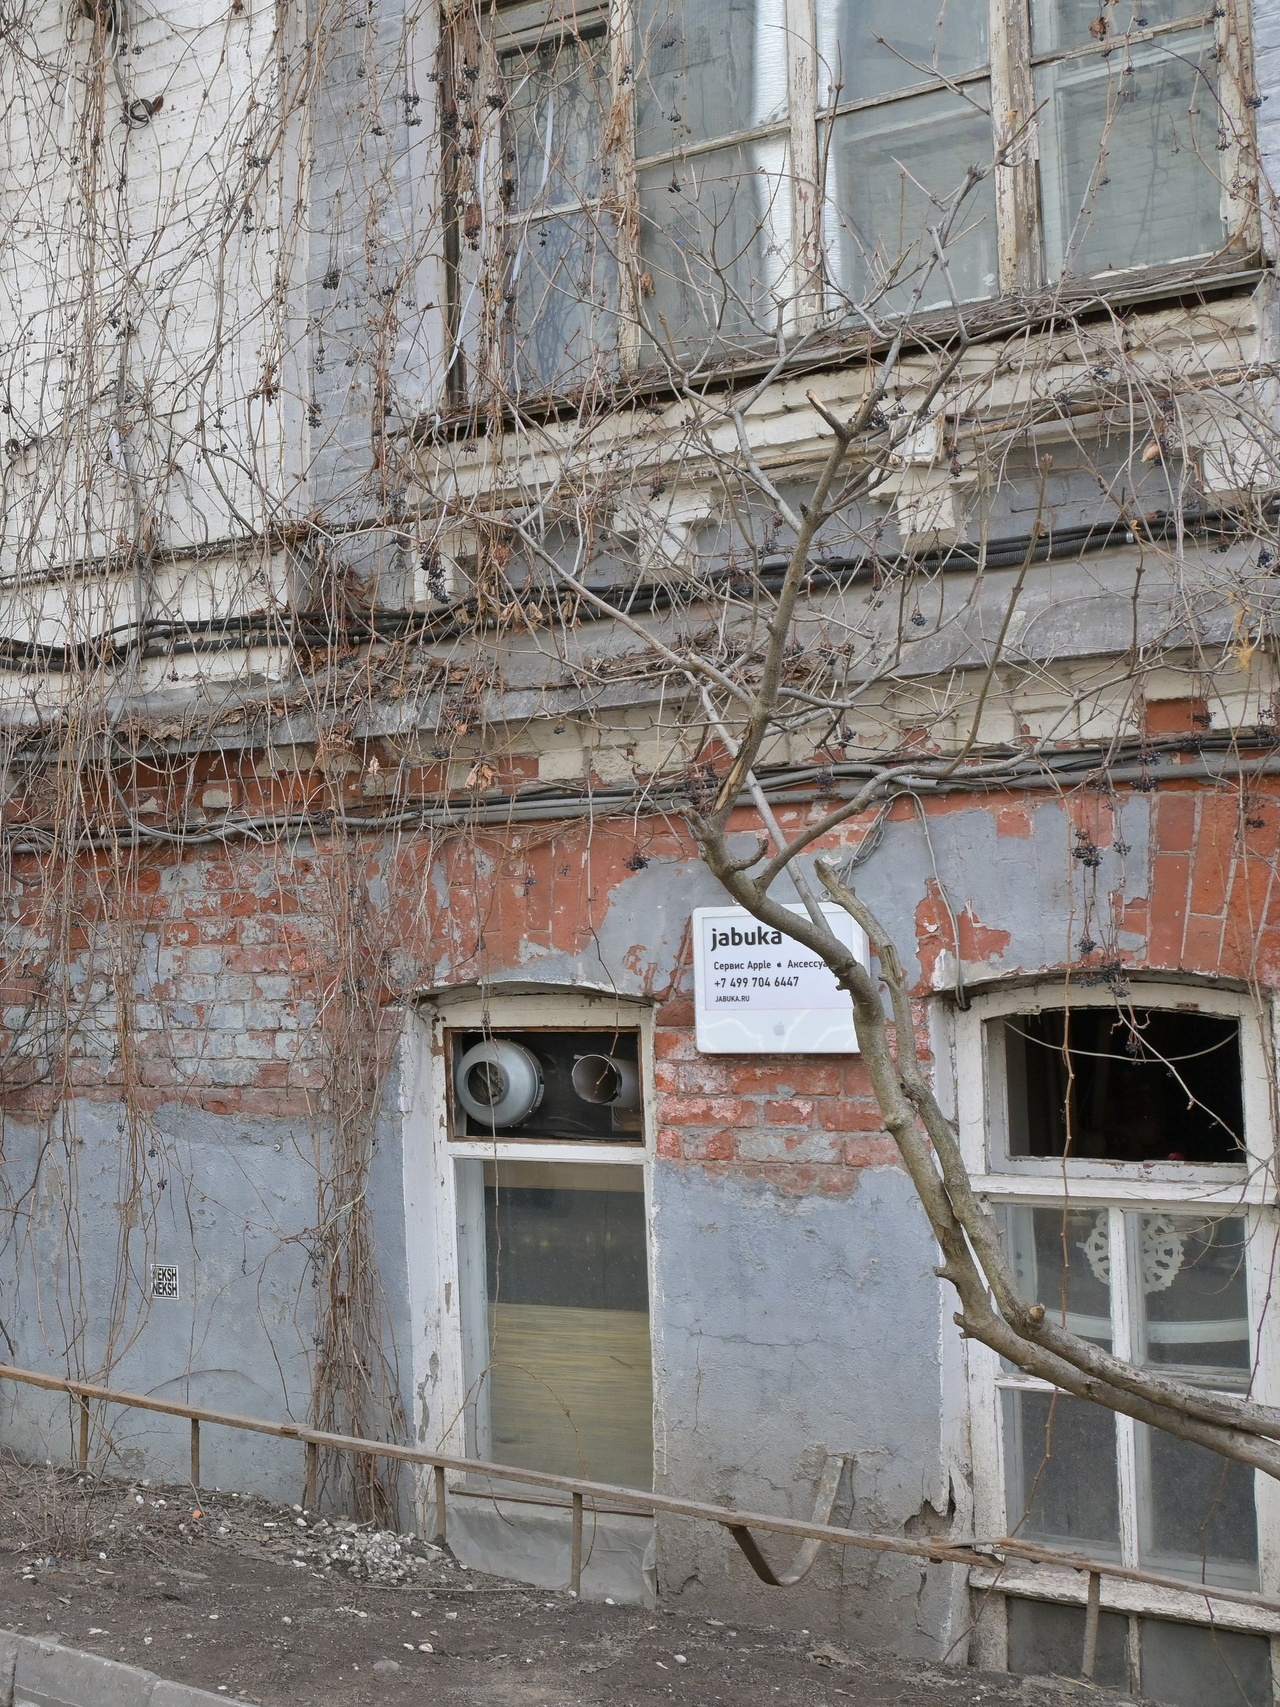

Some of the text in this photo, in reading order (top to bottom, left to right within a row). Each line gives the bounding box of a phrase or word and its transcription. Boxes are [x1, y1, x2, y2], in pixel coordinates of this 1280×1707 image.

[711, 926, 783, 952] jabuka
[714, 959, 829, 972] Сервис Apple Аксессуа
[714, 976, 799, 988] +7 499 704 6447
[715, 995, 750, 1003] JABUKA.RU
[152, 1268, 177, 1282] EKSH
[152, 1282, 178, 1296] NEKSH
